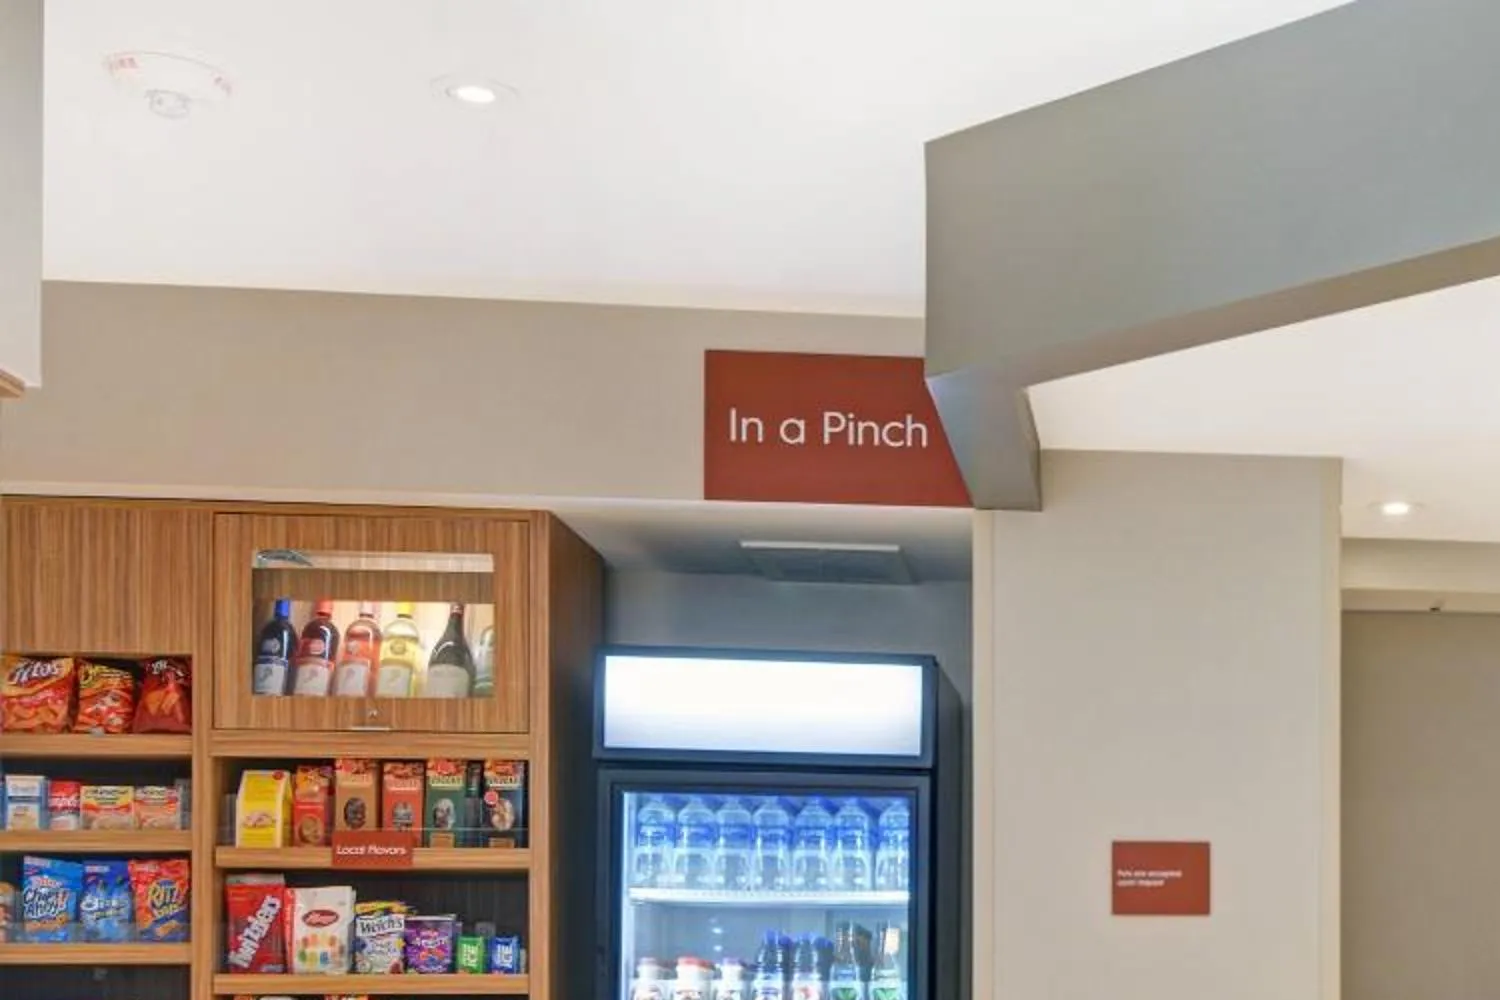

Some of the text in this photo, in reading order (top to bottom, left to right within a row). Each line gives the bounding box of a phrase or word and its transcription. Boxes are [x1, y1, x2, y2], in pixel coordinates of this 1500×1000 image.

[729, 407, 929, 449] In a Pinch
